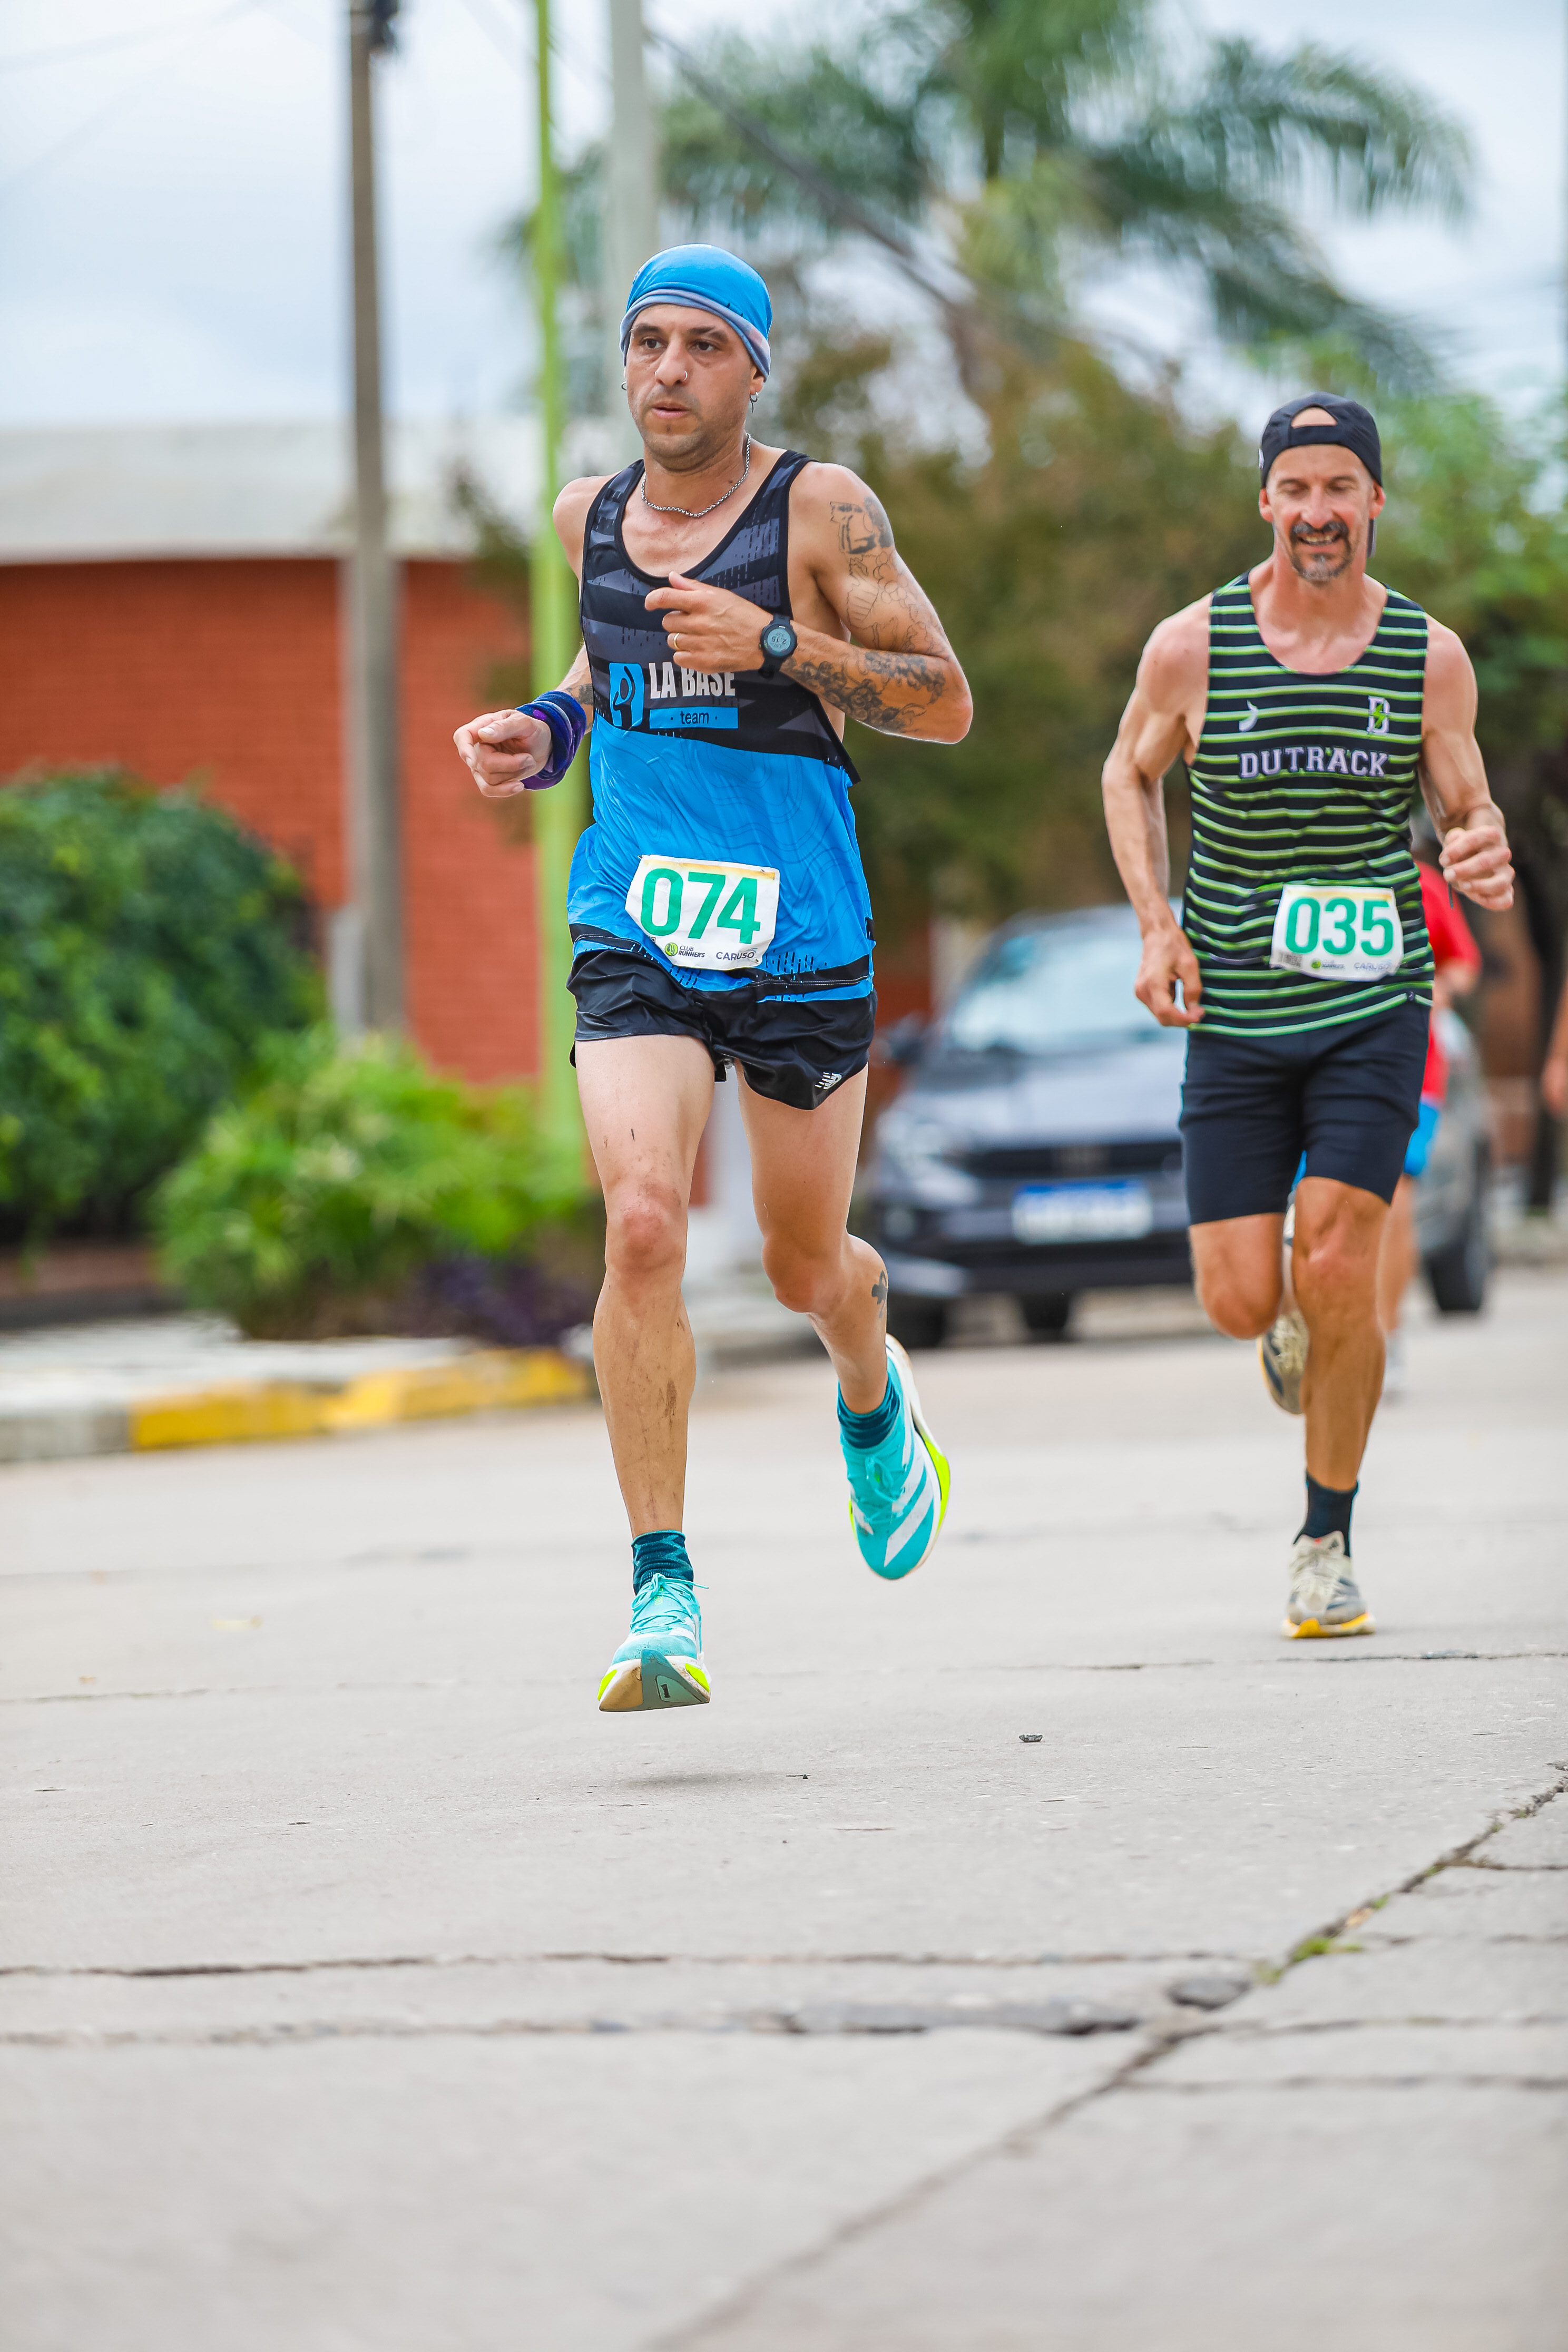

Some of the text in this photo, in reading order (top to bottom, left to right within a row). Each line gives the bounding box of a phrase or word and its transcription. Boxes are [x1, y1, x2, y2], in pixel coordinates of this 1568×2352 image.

[649, 661, 735, 699] LA BASE
[680, 710, 709, 724] team
[1240, 745, 1388, 779] DUTRACK
[640, 867, 761, 945] 074
[1286, 897, 1394, 956] 035
[716, 951, 754, 961] CARUSO
